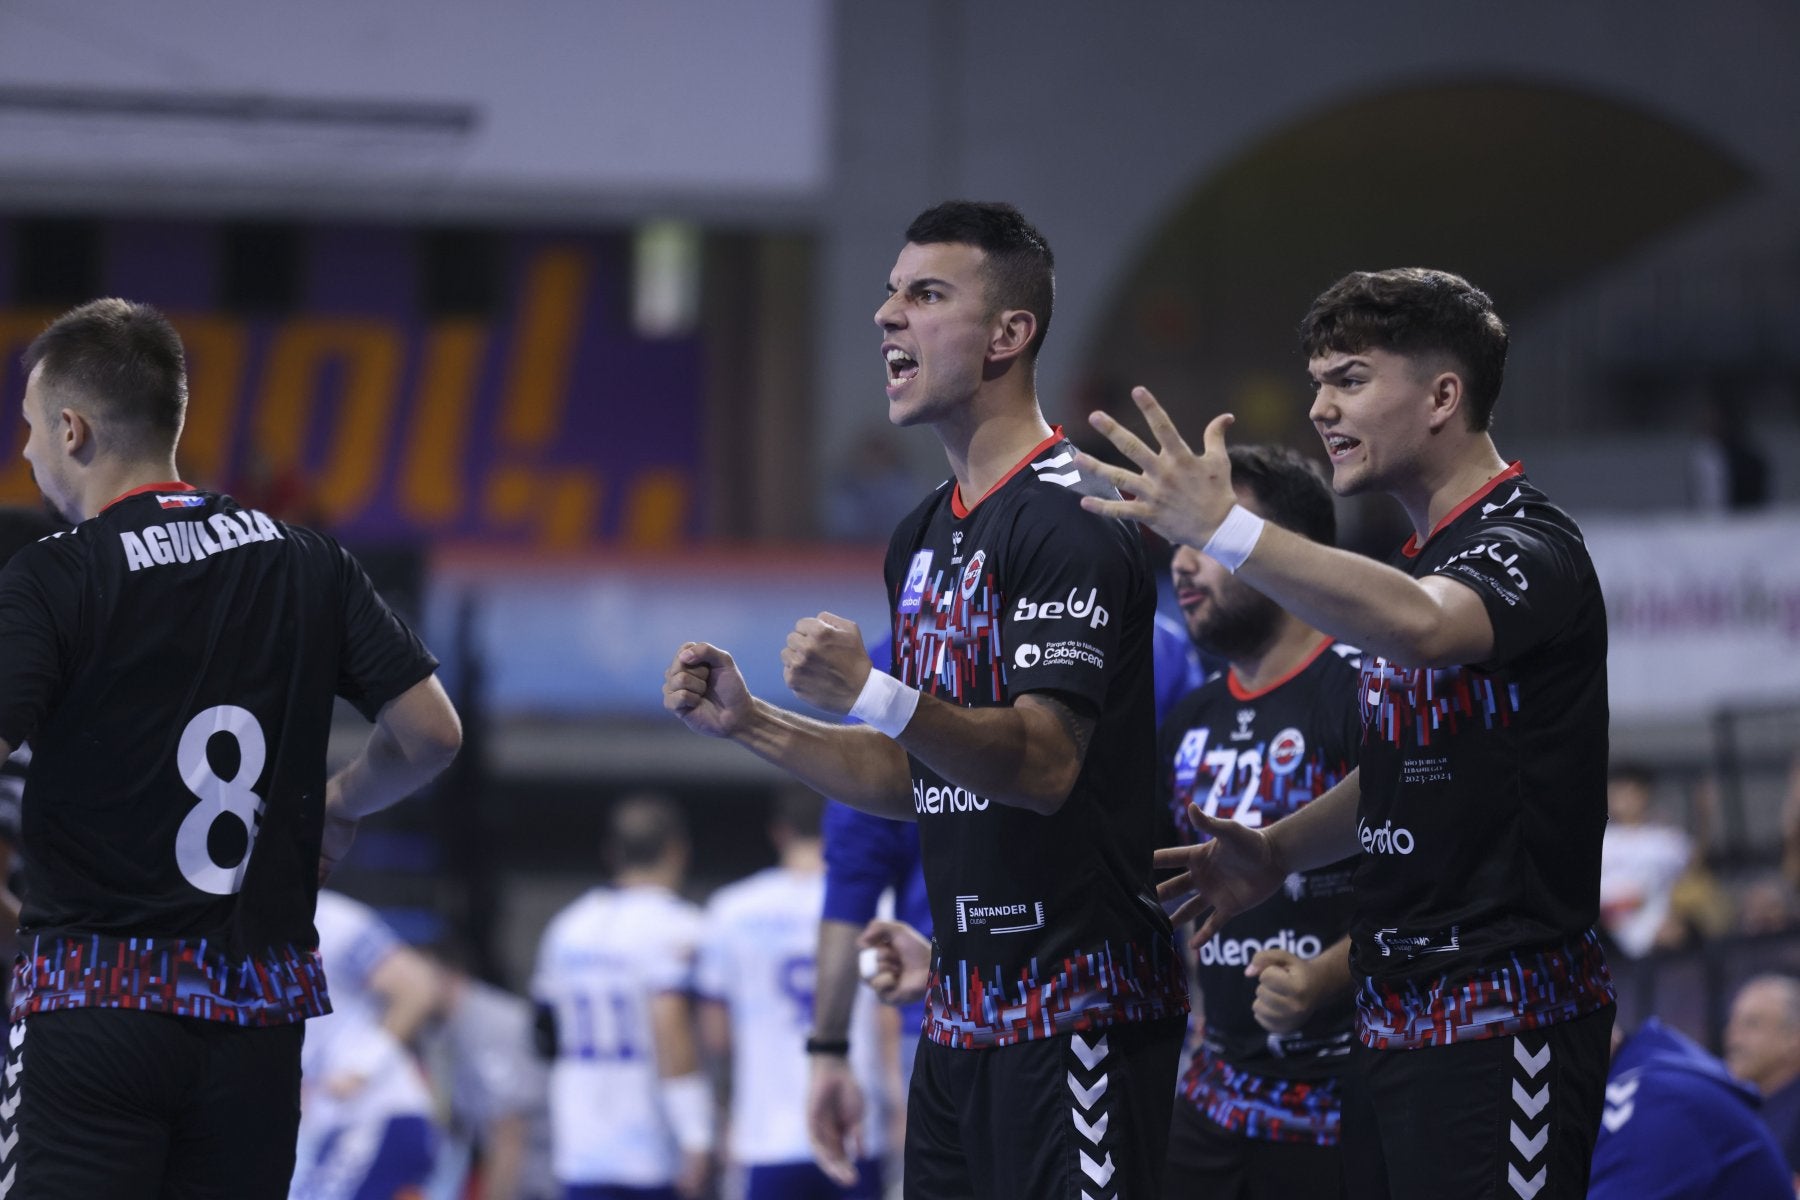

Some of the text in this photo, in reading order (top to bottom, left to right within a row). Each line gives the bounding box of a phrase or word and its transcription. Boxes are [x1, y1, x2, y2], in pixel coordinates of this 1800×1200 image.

[119, 509, 285, 572] AGUILELLA
[1044, 646, 1104, 669] Cabárceno
[175, 704, 267, 895] 8
[1204, 748, 1262, 827] 72
[969, 904, 1027, 917] SANTANDER
